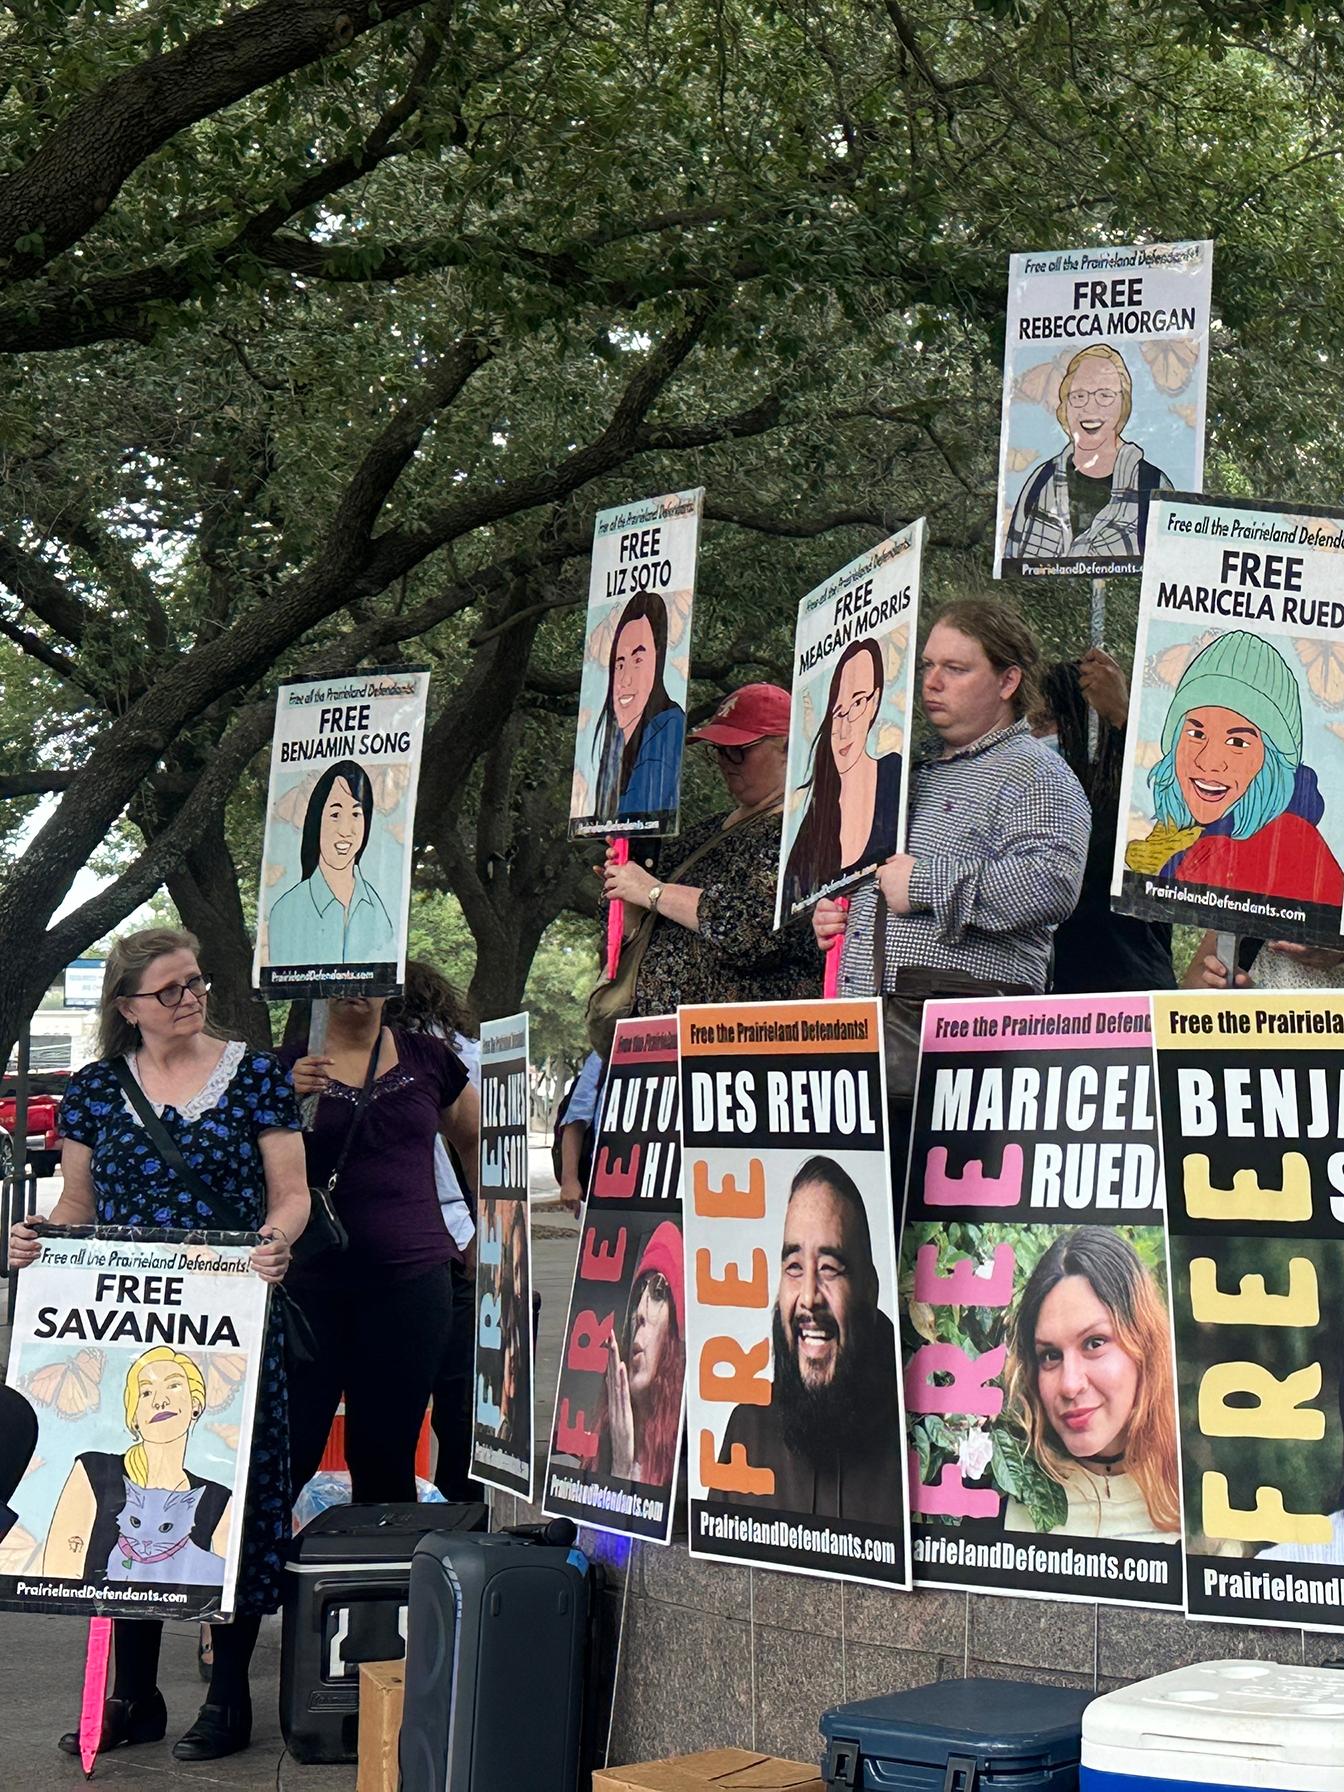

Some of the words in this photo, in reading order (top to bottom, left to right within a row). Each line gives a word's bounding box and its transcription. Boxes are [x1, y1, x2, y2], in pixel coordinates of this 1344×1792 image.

[1025, 259, 1046, 274] Free
[1049, 256, 1062, 272] all
[1064, 256, 1078, 270] the
[1081, 252, 1136, 270] Prairieland
[1074, 278, 1142, 310] FREE
[1020, 314, 1103, 340] REBECCA
[1107, 308, 1196, 335] MORGAN
[620, 528, 661, 563] FREE
[1168, 513, 1192, 532] Free
[1195, 516, 1209, 534] all
[1211, 520, 1230, 536] the
[1230, 519, 1298, 544] Prairieland
[606, 569, 627, 598] LIZ
[630, 560, 672, 592] SOTO
[1220, 550, 1304, 592] FREE
[834, 579, 873, 626] FREE
[1157, 582, 1274, 621] MARICELA
[799, 620, 852, 676] MEAGAN
[855, 586, 910, 638] MORRIS
[319, 704, 370, 734] FREE
[281, 735, 355, 762] BENJAMIN
[359, 732, 410, 754] SONG
[1145, 881, 1306, 922] PrairielandDefendants.com
[690, 1024, 714, 1044] Free
[717, 1023, 734, 1043] the
[737, 1020, 799, 1042] Prairieland
[801, 1018, 868, 1041] Defendants!
[936, 1018, 968, 1038] Free
[972, 1016, 998, 1036] the
[1001, 1013, 1092, 1036] Prairieland
[1170, 1010, 1213, 1034] Free
[1218, 1010, 1250, 1033] the
[483, 1077, 498, 1128] LIZ
[603, 1076, 680, 1133] AUTU
[691, 1070, 757, 1134] DES
[767, 1069, 876, 1134] REVOL
[930, 1065, 1154, 1132] MARICEL
[41, 1248, 68, 1264] Free
[108, 1251, 177, 1270] Prairieland
[178, 1254, 250, 1274] Defendants!
[96, 1274, 184, 1306] FREE
[556, 1144, 640, 1457] FREE
[34, 1306, 240, 1347] SAVANNA
[693, 1158, 776, 1496] FREE
[905, 1143, 1023, 1518] FREE
[1182, 1151, 1333, 1545] FREE
[550, 1473, 664, 1522] PrairielandDefendants.com
[700, 1511, 895, 1566] PrairielandDefendants.com
[17, 1582, 187, 1603] PrairielandDefendants.com
